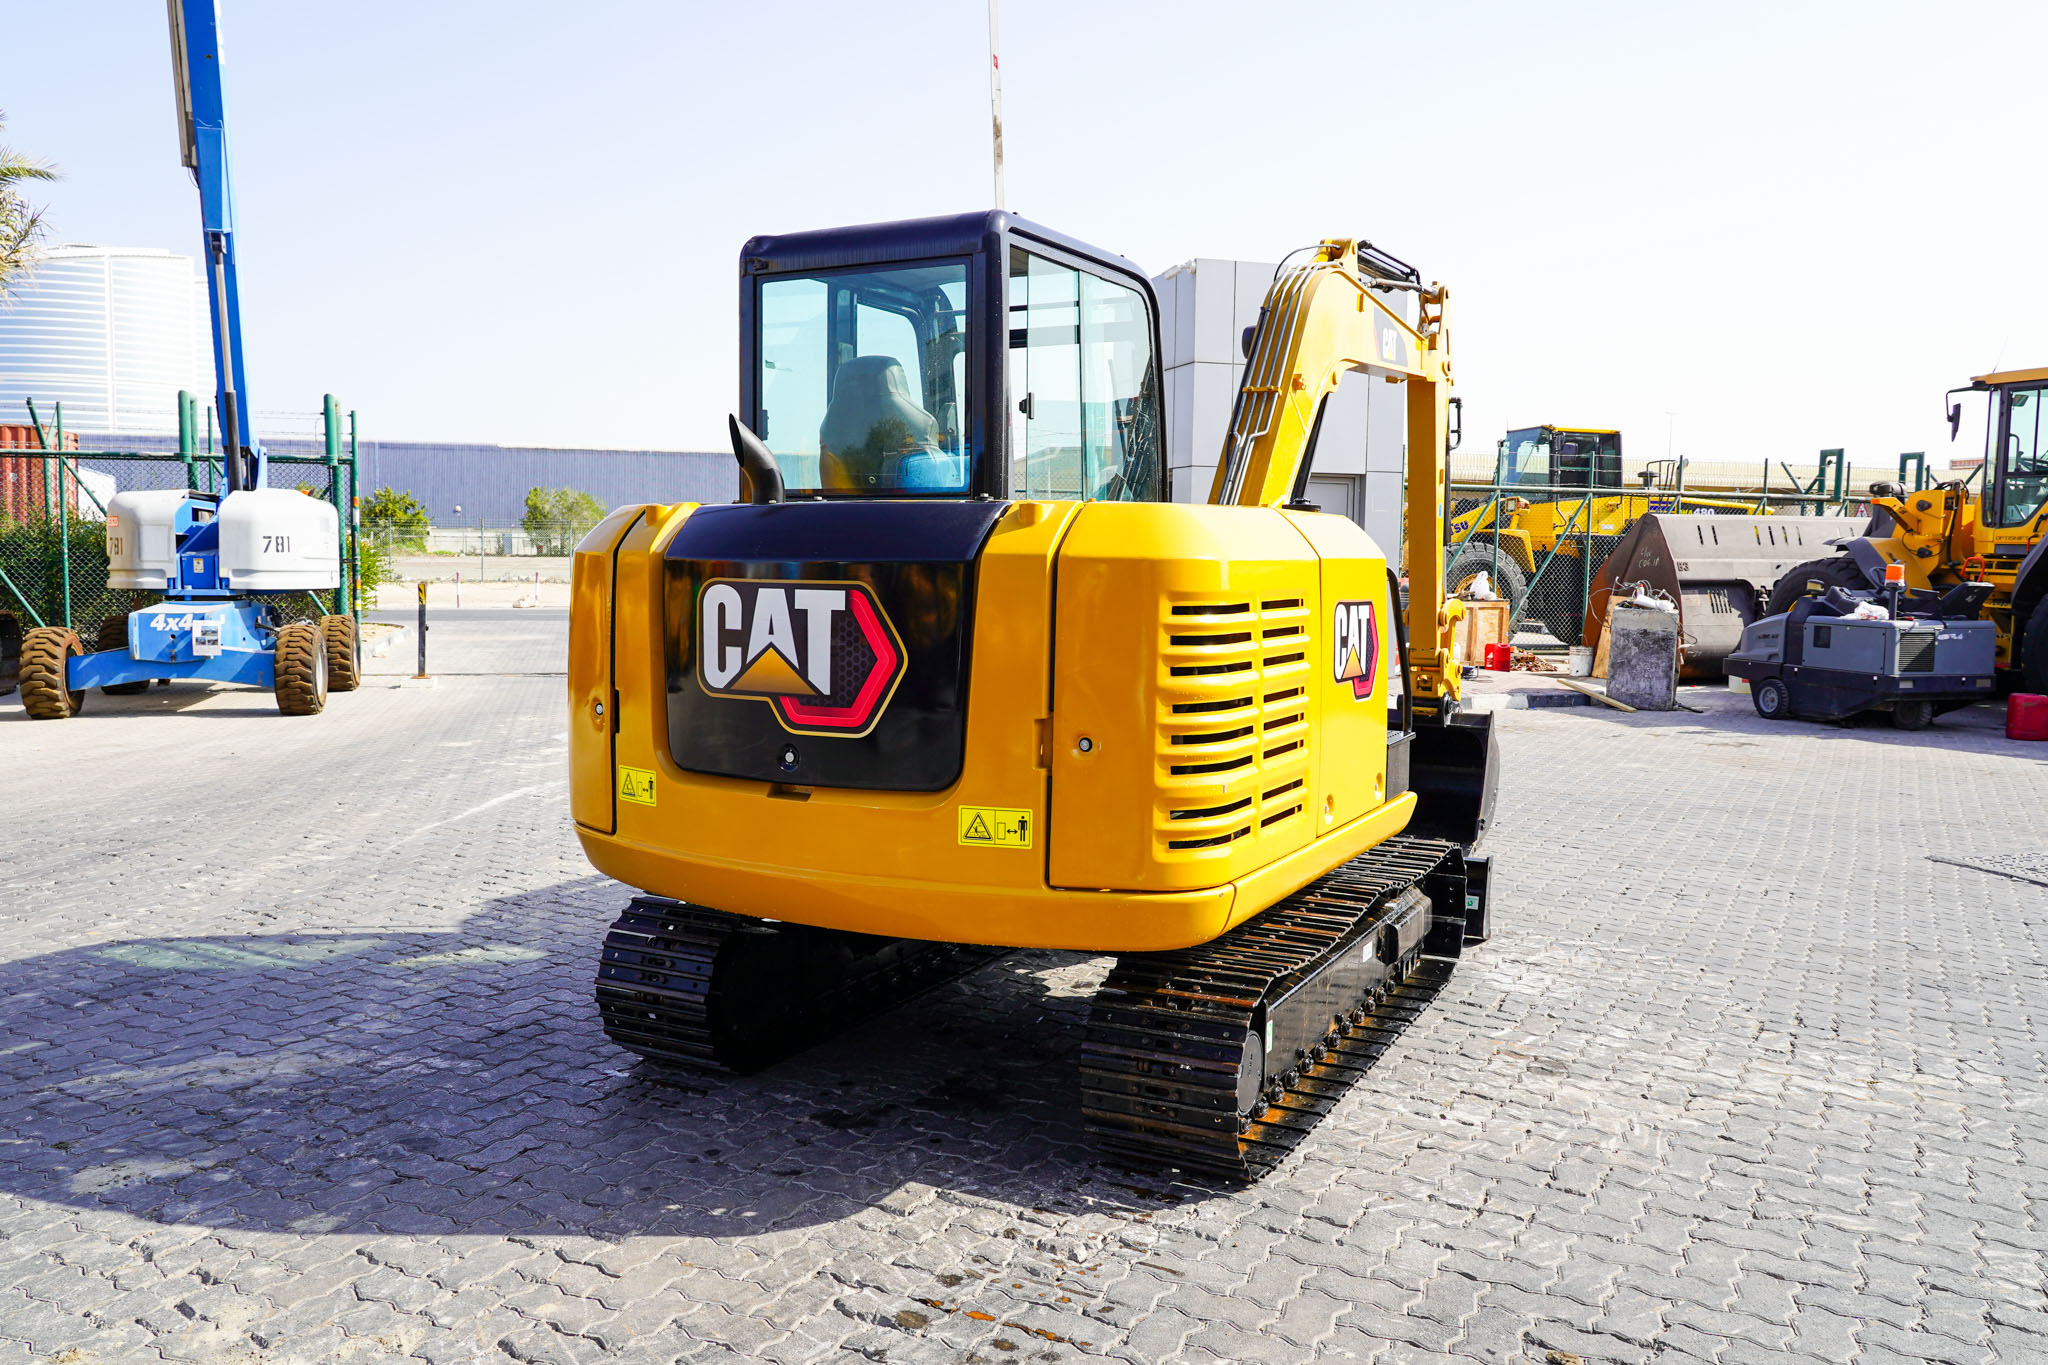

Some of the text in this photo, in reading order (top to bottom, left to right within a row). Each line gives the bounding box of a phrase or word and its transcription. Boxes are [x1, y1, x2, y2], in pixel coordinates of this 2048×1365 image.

[1383, 327, 1397, 361] CAT
[263, 536, 290, 553] 781
[150, 613, 193, 631] 4x4
[703, 583, 846, 695] CAT
[1334, 603, 1370, 679] CAT
